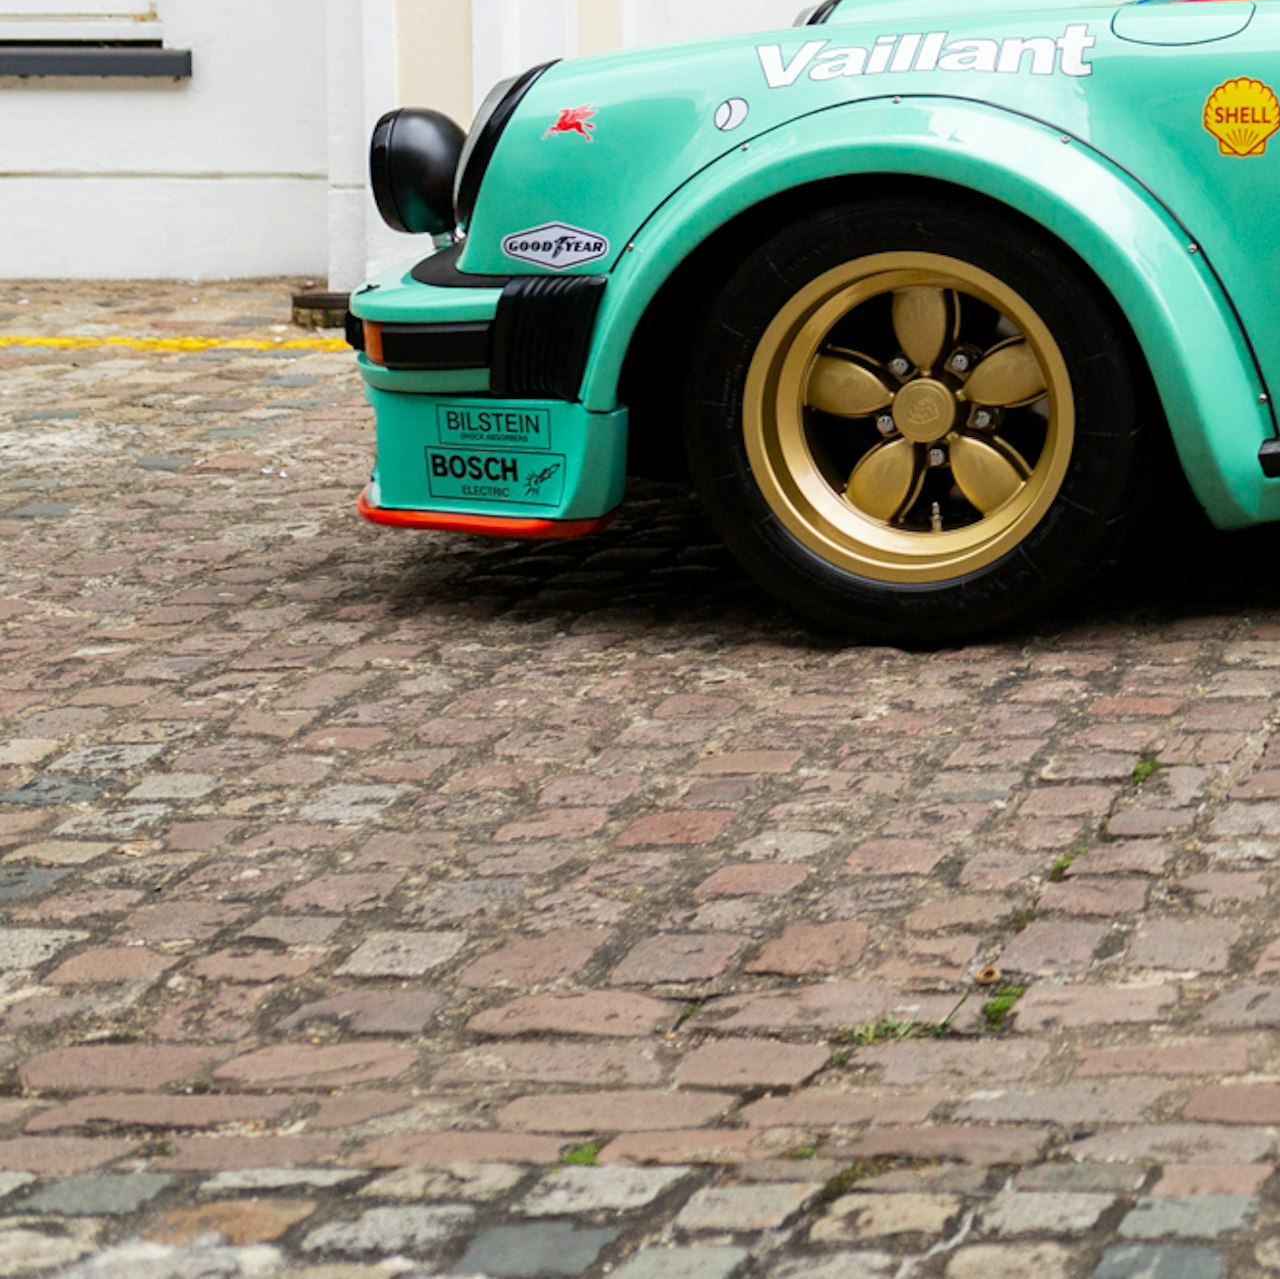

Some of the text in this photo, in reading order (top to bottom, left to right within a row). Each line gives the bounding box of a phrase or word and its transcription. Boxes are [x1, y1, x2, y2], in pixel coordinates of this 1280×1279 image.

[755, 23, 1096, 89] Vaillant
[1214, 107, 1271, 124] SHELL
[446, 411, 540, 433] BILSTEIN
[431, 453, 519, 482] BOSCH
[462, 484, 510, 498] ELECTRIC
